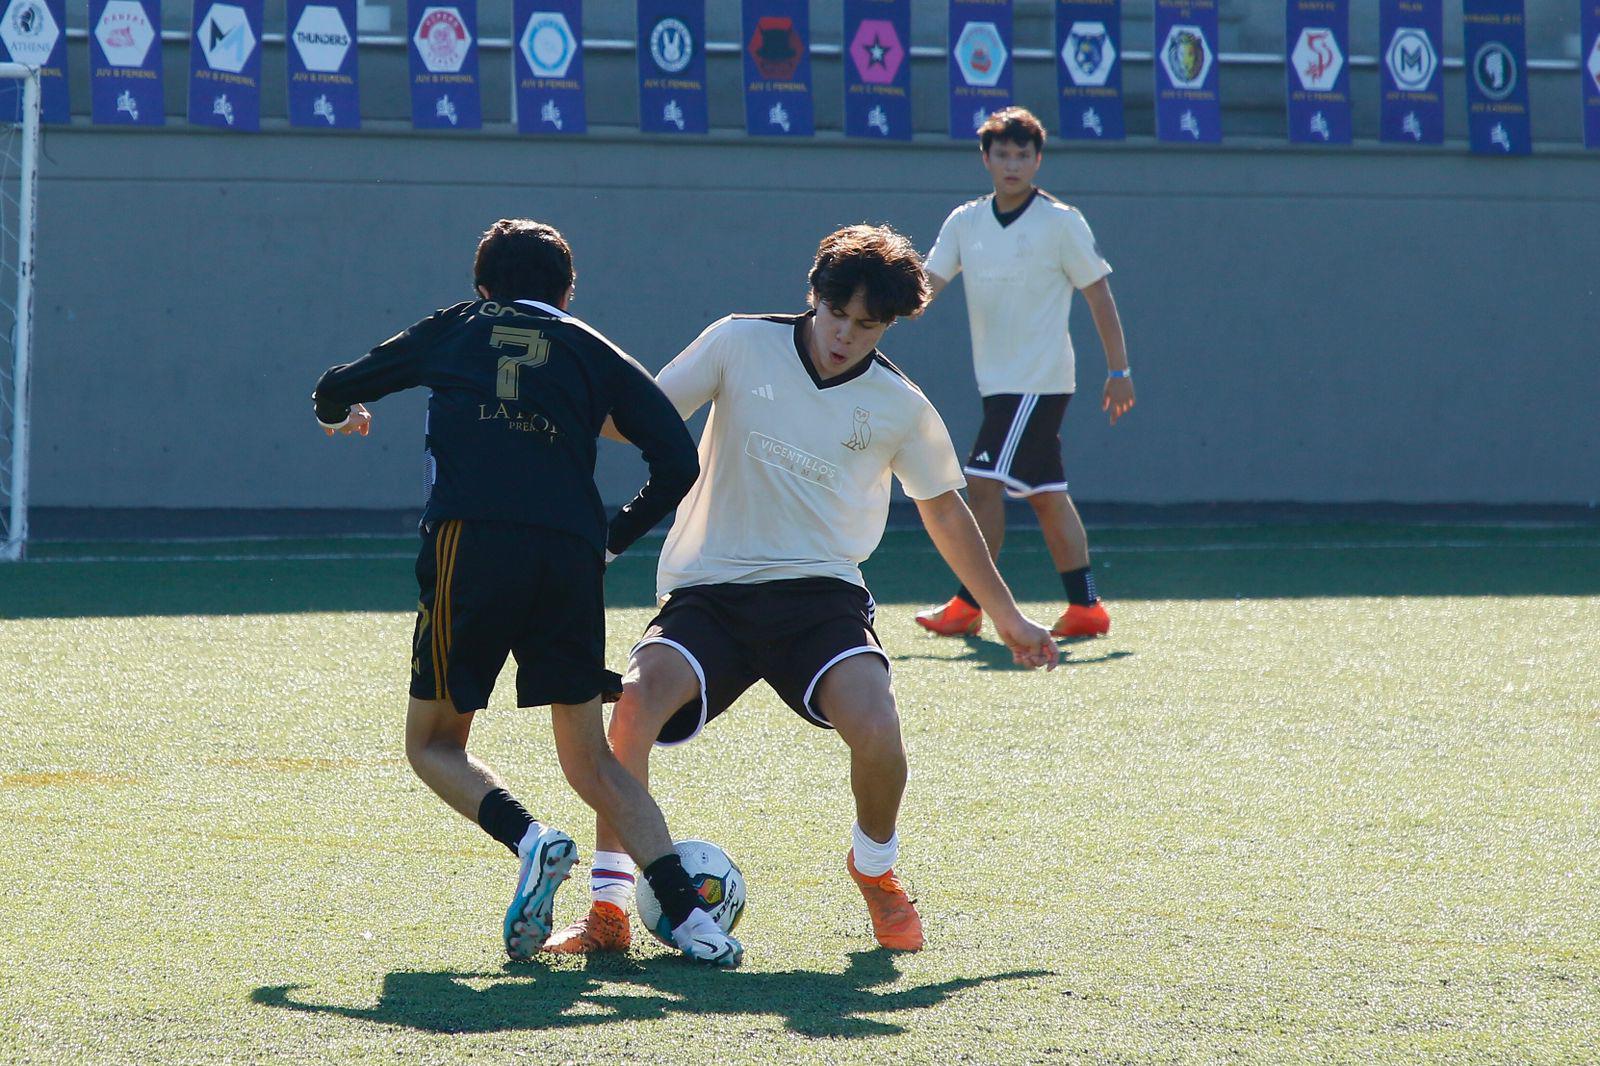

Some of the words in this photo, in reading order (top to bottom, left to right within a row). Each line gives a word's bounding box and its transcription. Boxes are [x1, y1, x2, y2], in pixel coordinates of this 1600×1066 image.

[297, 32, 349, 46] THUNDERS
[489, 325, 551, 400] 7
[478, 402, 511, 421] LA
[760, 439, 836, 478] VICENTILLO'S
